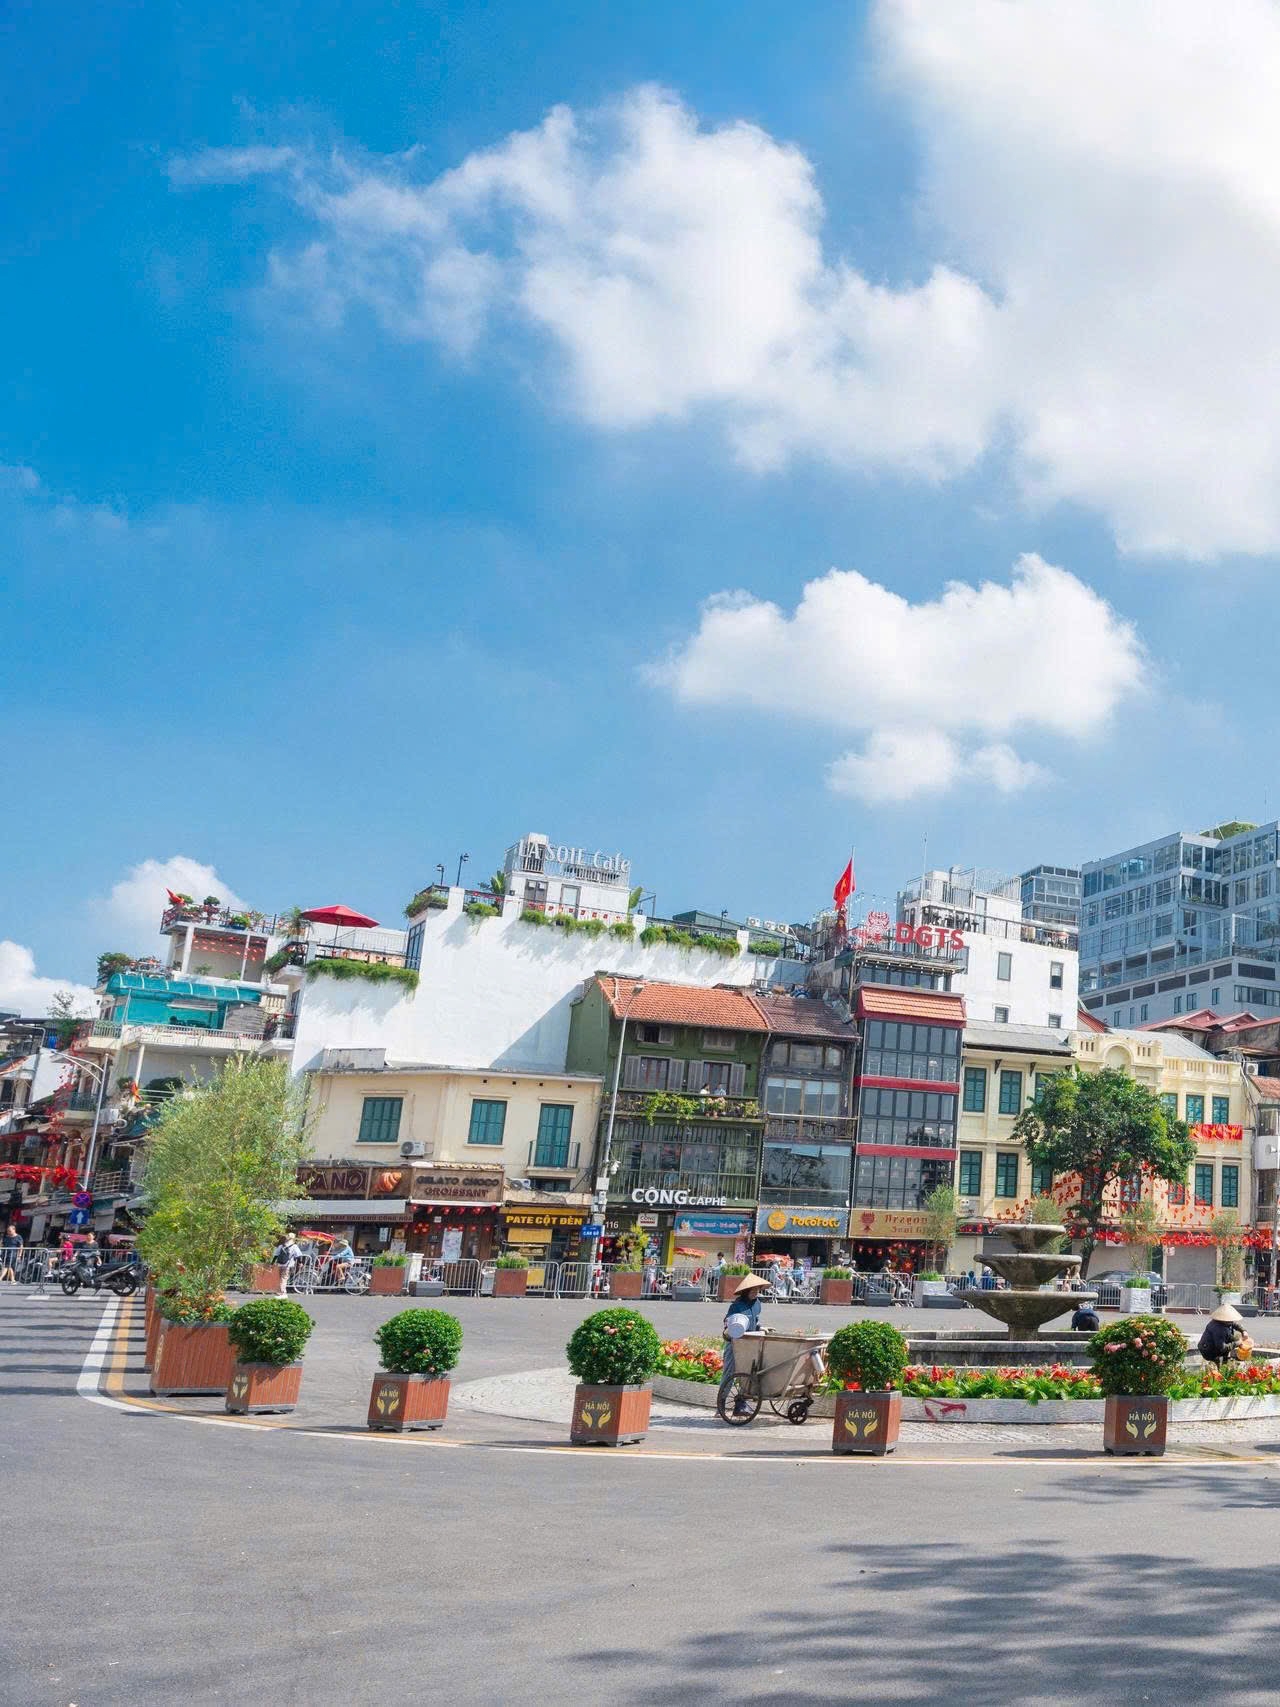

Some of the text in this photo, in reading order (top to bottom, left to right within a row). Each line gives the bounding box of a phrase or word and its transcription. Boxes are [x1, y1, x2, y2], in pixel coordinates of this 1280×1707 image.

[545, 843, 586, 867] SOIL
[895, 922, 965, 950] DGTS
[416, 1175, 499, 1187] GELATO CHOCO
[424, 1187, 489, 1197] CROISSANT
[631, 1186, 688, 1206] CỘNG
[506, 1215, 534, 1224] PATE
[606, 1221, 619, 1229] 116
[585, 1401, 595, 1410] HÀ
[848, 1409, 876, 1420] HÀ NỘI
[1129, 1411, 1155, 1422] HÀ NỘI
